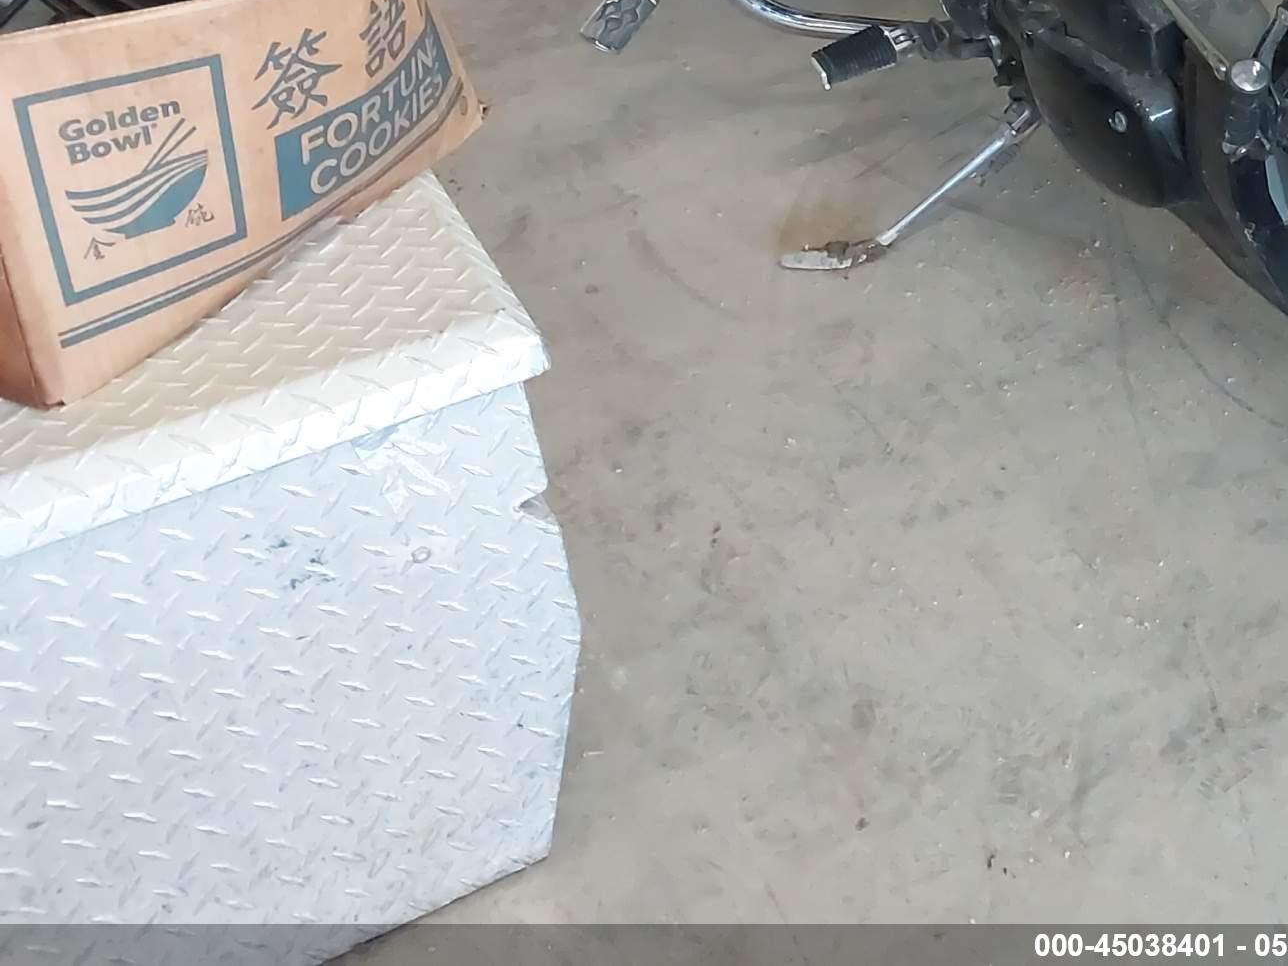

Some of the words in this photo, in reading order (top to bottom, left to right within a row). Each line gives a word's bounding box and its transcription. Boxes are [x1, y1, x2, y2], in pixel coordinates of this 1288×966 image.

[58, 100, 181, 142] Golden
[302, 36, 438, 165] FORTUN
[65, 124, 153, 166] Bowl
